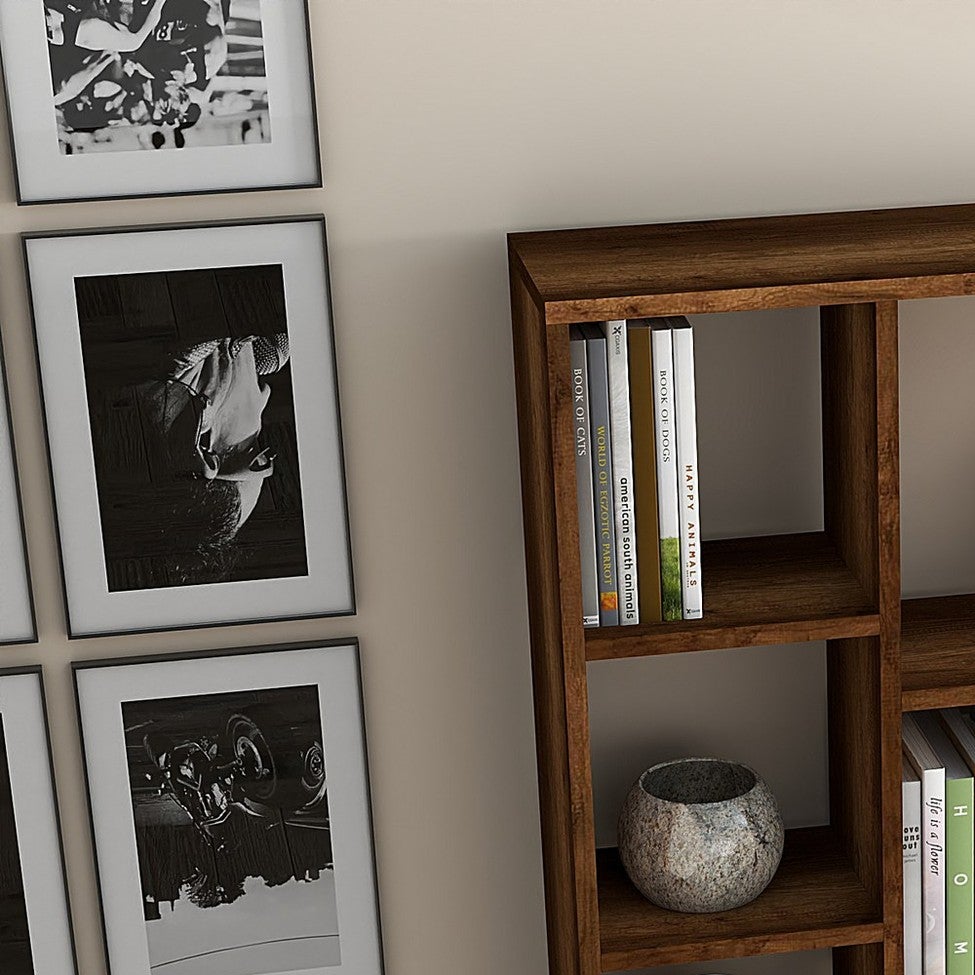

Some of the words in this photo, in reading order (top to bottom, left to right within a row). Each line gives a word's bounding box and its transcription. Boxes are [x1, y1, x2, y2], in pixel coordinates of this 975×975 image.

[574, 369, 583, 402] BOOK
[659, 370, 668, 403] BOOK
[576, 407, 584, 423] OF
[660, 409, 669, 425] OF
[577, 427, 586, 456] CATS
[596, 426, 608, 467] WORLD
[661, 430, 671, 463] DOGS
[598, 471, 608, 486] OF
[685, 465, 694, 511] HAPPY
[599, 490, 611, 539] EGZOTIC
[619, 478, 631, 534] american
[601, 543, 612, 585] PARROT
[623, 537, 633, 570] south
[687, 522, 697, 587] ANIMALS
[624, 573, 635, 619] animals
[926, 798, 943, 814] life
[904, 834, 920, 842] uns
[931, 820, 942, 828] is
[903, 842, 917, 850] out
[926, 841, 942, 876] flower
